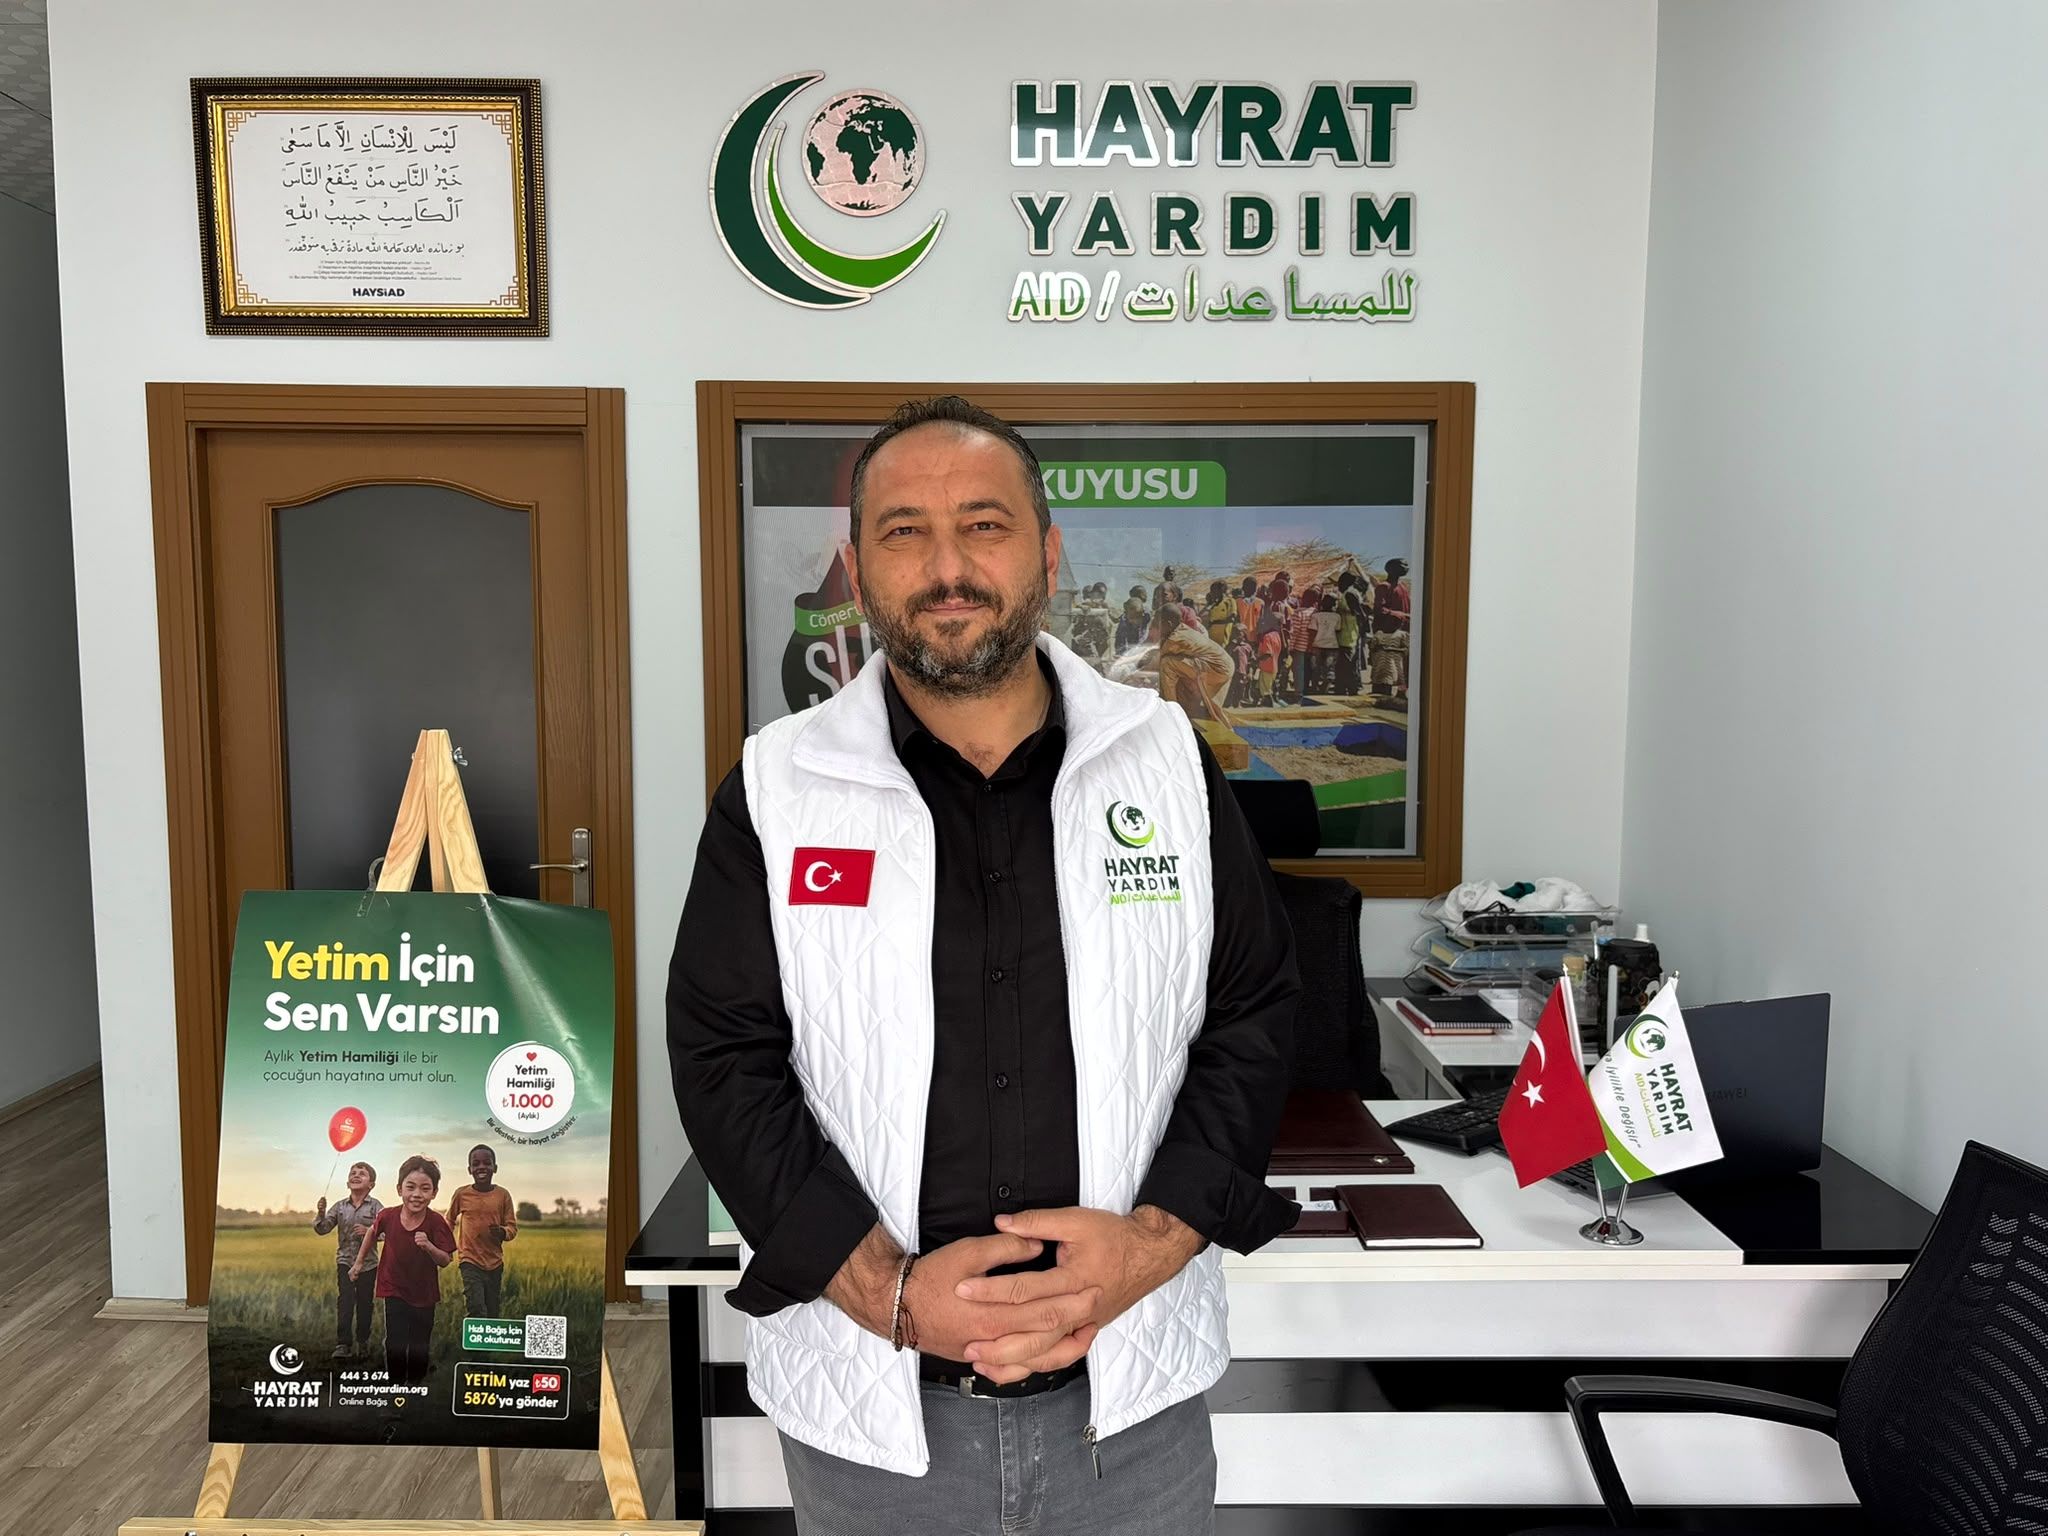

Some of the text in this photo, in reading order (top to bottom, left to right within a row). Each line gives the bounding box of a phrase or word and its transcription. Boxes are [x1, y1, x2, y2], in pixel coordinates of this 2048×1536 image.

[1013, 82, 1416, 165] HAYRAT
[1012, 193, 1416, 254] YARDIM
[1009, 271, 1090, 321] AID
[1123, 265, 1416, 323] للمساعدات
[1041, 468, 1198, 501] KUYUSU
[1104, 855, 1180, 877] HAYRAT
[1107, 876, 1180, 892] YARDIM
[264, 931, 475, 987] Yetim İçin
[263, 991, 500, 1035] Sen Varsın
[263, 1050, 438, 1065] Aylık Yetim Hamiliği ile bir
[263, 1069, 457, 1084] çocuğun hayatına umut olun.
[515, 1064, 548, 1075] Yetim
[506, 1077, 555, 1091] Hamiliği
[1646, 1068, 1675, 1135] YARDIM
[1660, 1062, 1693, 1132] HAYRAT
[517, 1136, 528, 1145] bir
[508, 1323, 523, 1335] İçin
[468, 1334, 521, 1345] QR okutunuz
[339, 1371, 389, 1381] 444 3 674
[464, 1370, 507, 1388] YETİM
[508, 1379, 531, 1390] yaz
[253, 1381, 323, 1395] HAYRAT
[339, 1383, 429, 1396] hayratyardim.org
[254, 1397, 320, 1408] YARDIM
[338, 1397, 389, 1408] Online Bağış
[463, 1391, 559, 1410] 5876'ya gönder
